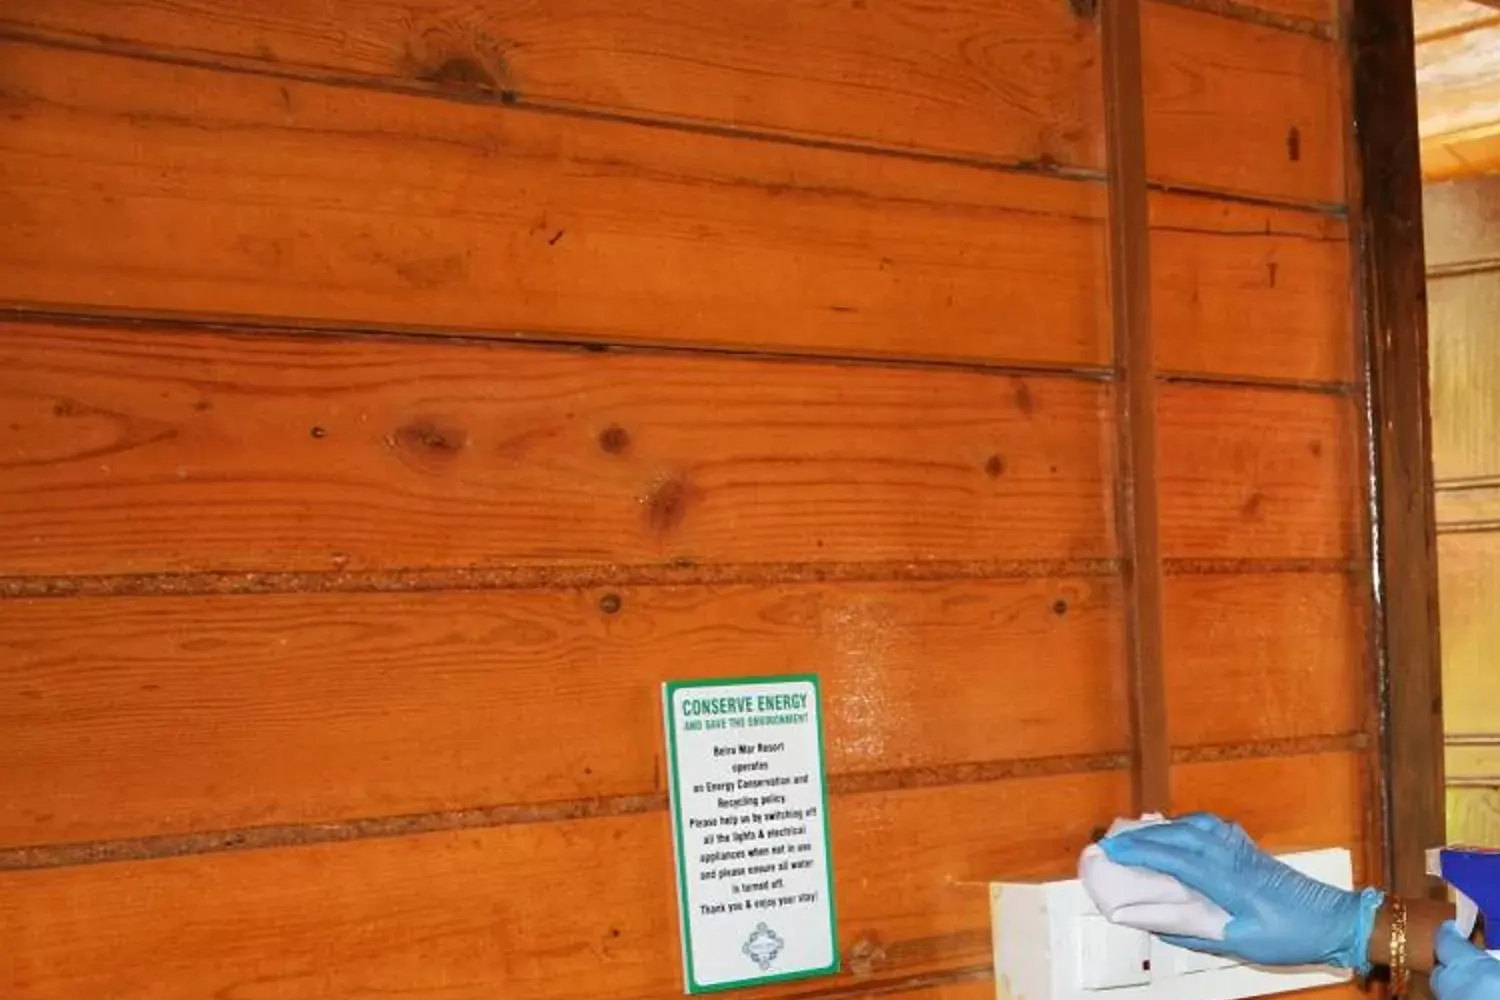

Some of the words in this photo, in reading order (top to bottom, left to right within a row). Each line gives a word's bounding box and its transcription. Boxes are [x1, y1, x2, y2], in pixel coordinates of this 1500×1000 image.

[682, 695, 753, 716] CONSERVE
[757, 692, 807, 711] ENERGY
[684, 719, 703, 731] AND
[705, 718, 727, 730] SAVE
[728, 717, 745, 728] THE
[748, 713, 808, 727] ENVIRONMENT
[713, 744, 737, 757] Beira
[738, 744, 755, 754] Mar
[757, 742, 785, 753] Resort
[731, 761, 768, 773] operates
[706, 781, 735, 793] Energy
[737, 776, 791, 789] Conservation
[794, 774, 809, 784] and
[718, 797, 758, 808] Recycling
[761, 795, 785, 806] policy
[689, 817, 717, 829] Please
[720, 815, 738, 826] help
[740, 815, 750, 824] us
[752, 813, 762, 824] by
[764, 809, 803, 821] switching
[805, 806, 817, 817] off
[704, 833, 714, 845] all
[716, 833, 730, 843] the
[732, 831, 756, 843] lights
[758, 829, 765, 839] &
[767, 827, 806, 839] electrical
[700, 850, 745, 864] appliances
[748, 847, 769, 857] when
[772, 844, 785, 855] not
[787, 844, 795, 853] in
[797, 843, 811, 852] use
[700, 870, 716, 881] and
[718, 867, 745, 880] please
[747, 864, 775, 875] ensure
[778, 860, 788, 871] all
[791, 859, 814, 870] water
[732, 885, 740, 894] is
[741, 880, 769, 893] turned
[700, 903, 726, 915] Thank
[728, 902, 743, 913] you
[745, 899, 752, 909] &
[754, 898, 777, 910] enjoy
[778, 895, 797, 907] your
